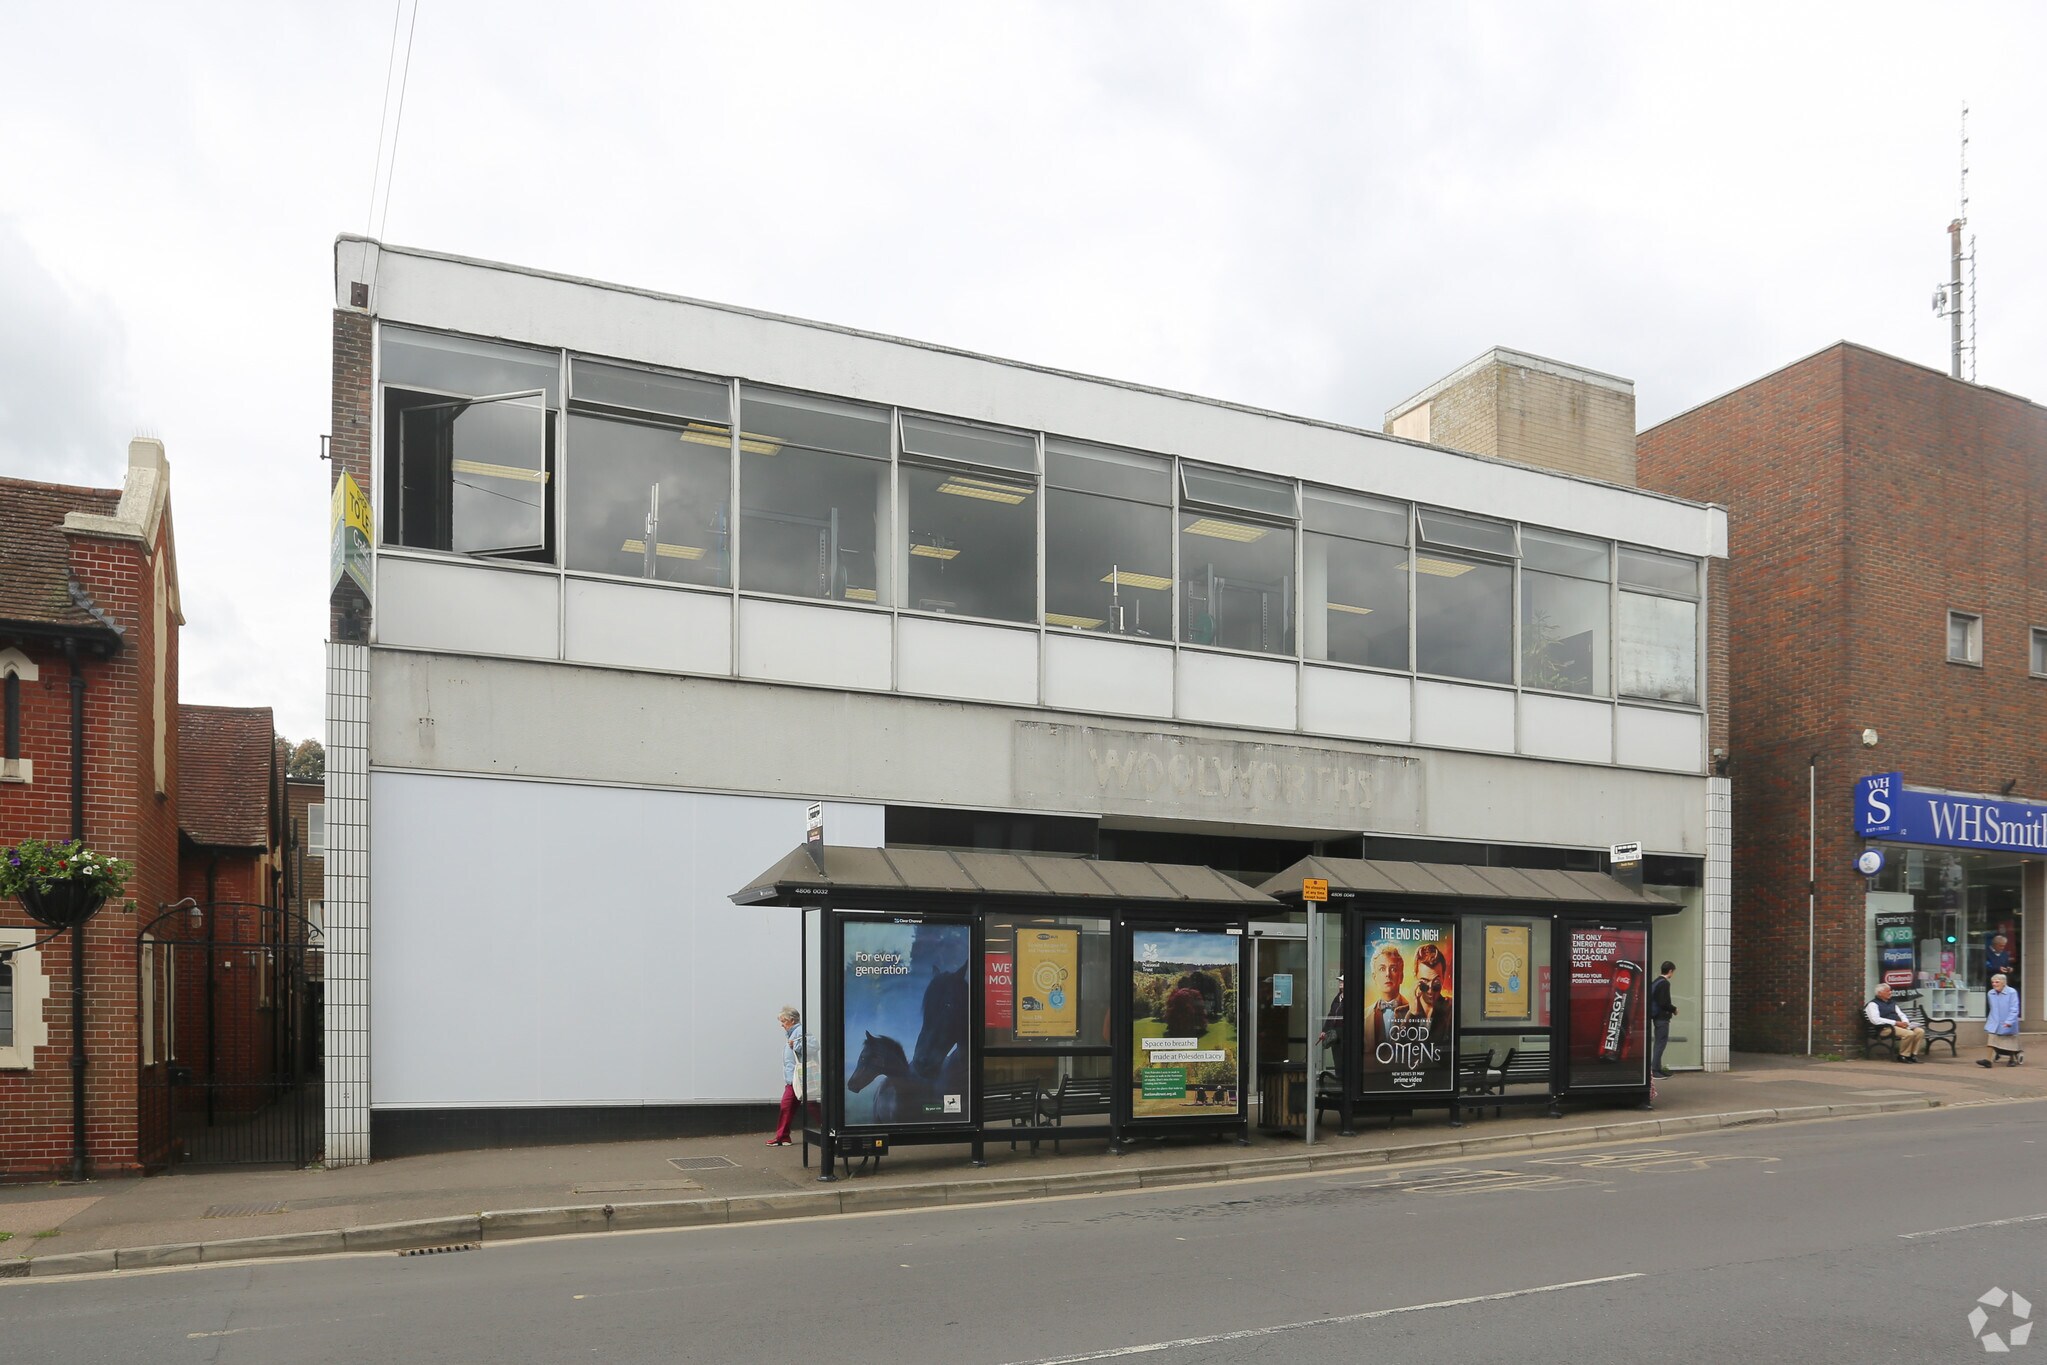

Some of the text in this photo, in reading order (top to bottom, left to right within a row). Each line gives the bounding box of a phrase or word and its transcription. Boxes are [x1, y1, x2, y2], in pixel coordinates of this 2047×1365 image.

[1089, 747, 1376, 809] WOOLWORTHS
[1868, 777, 1890, 790] WH
[1867, 788, 1891, 825] S
[1380, 927, 1439, 941] THE END IS NIGH
[855, 952, 901, 964] For every
[855, 964, 909, 977] generation
[1891, 989, 1906, 997] tore
[1604, 991, 1624, 1050] ENERGY
[1145, 1040, 1164, 1048] Space
